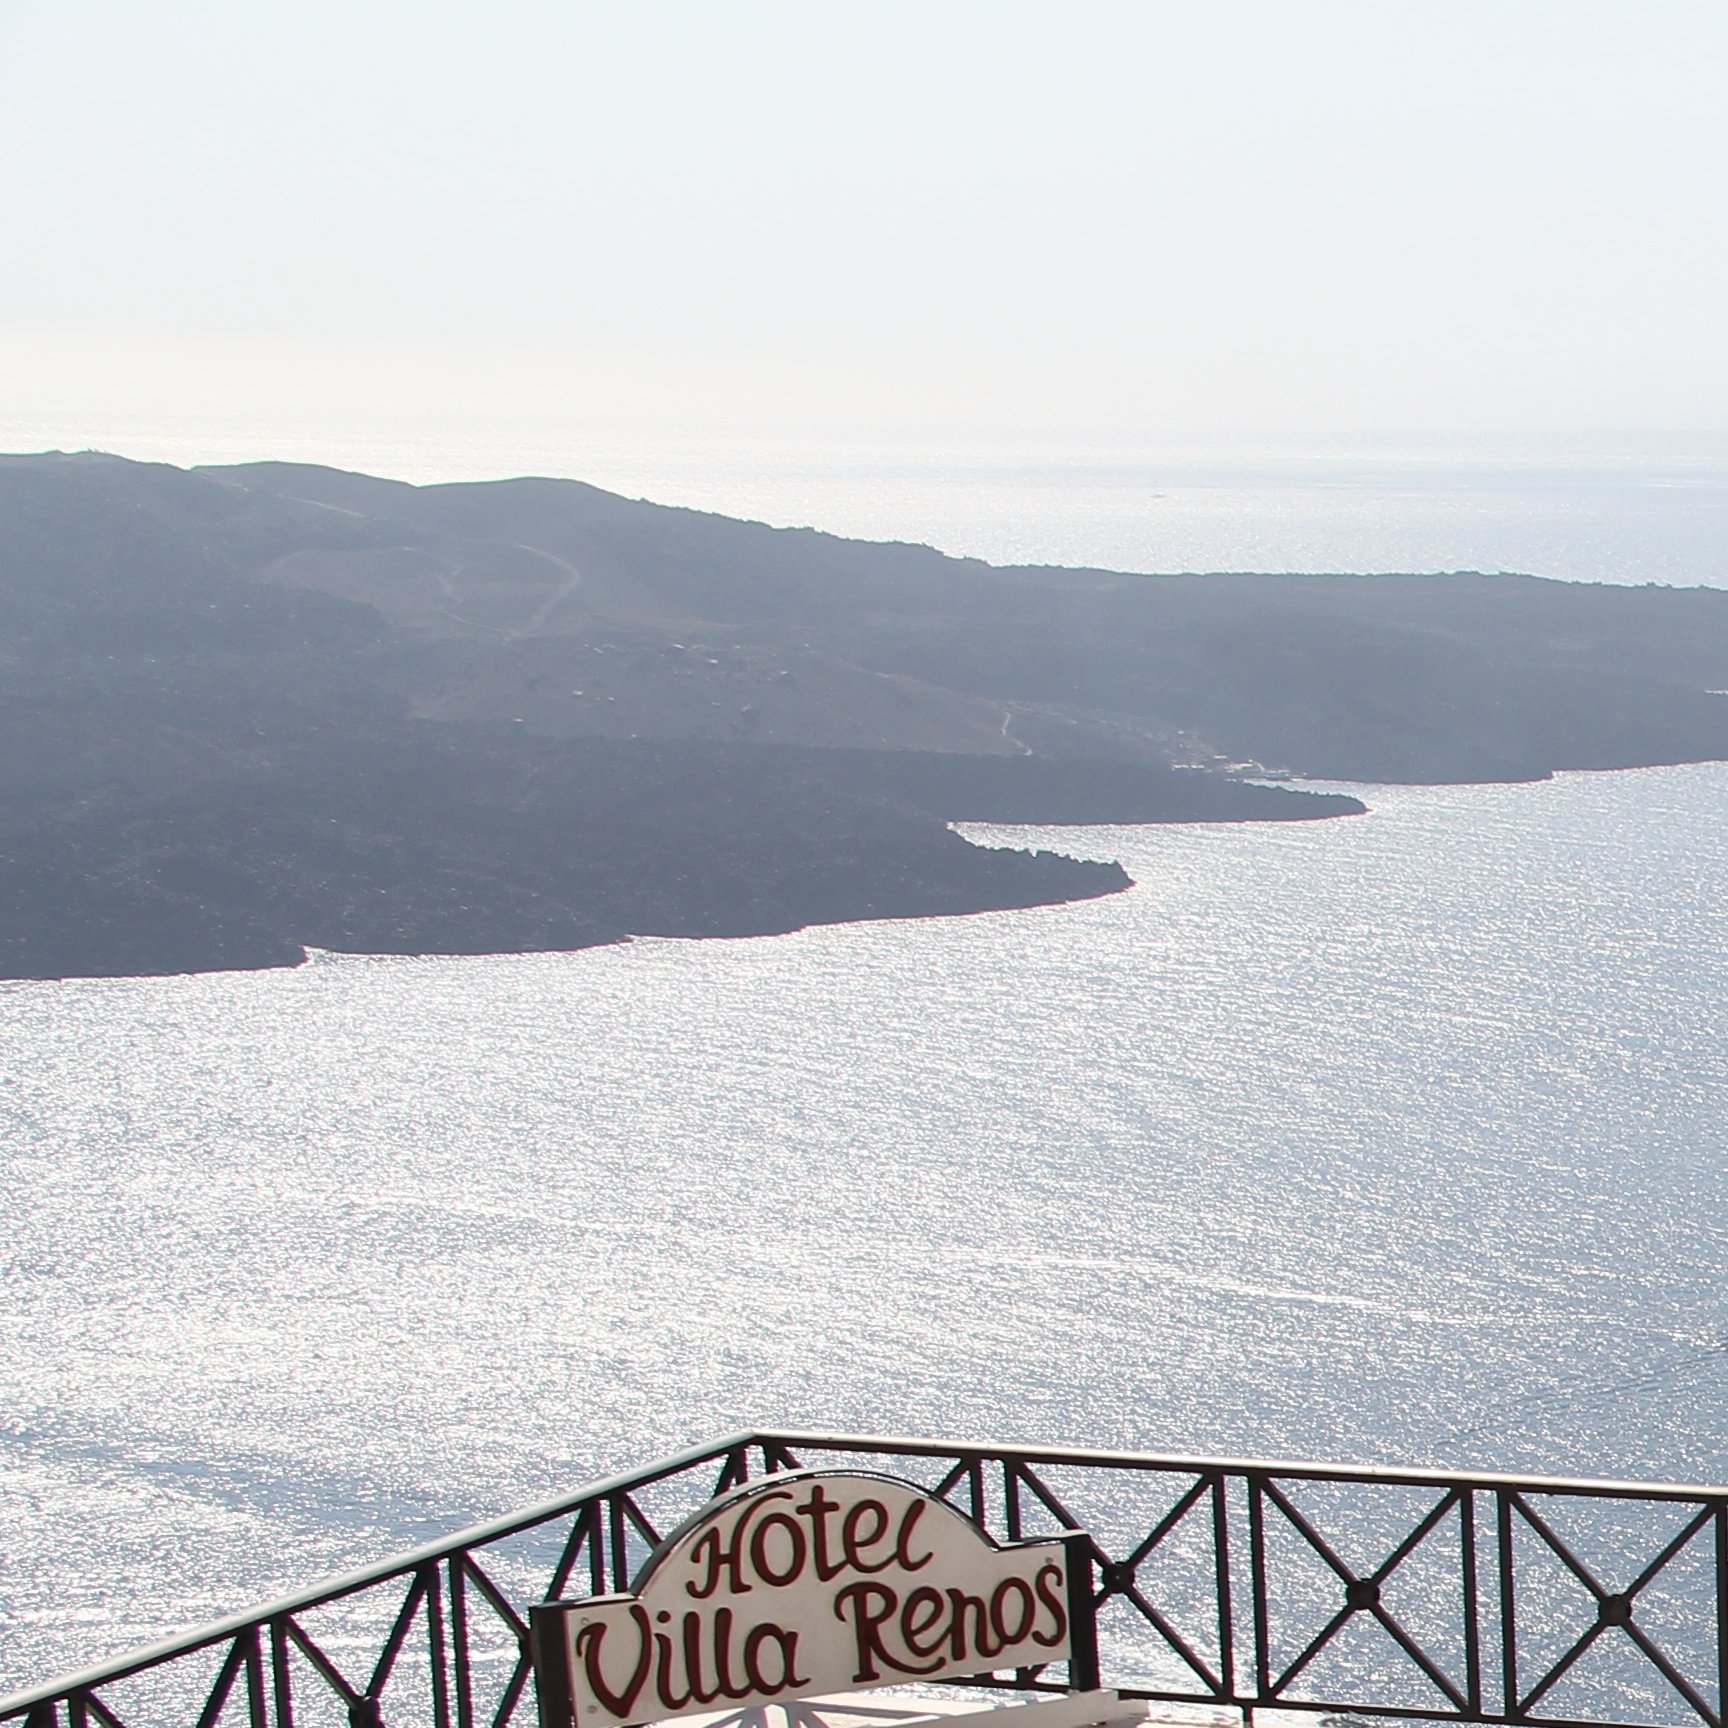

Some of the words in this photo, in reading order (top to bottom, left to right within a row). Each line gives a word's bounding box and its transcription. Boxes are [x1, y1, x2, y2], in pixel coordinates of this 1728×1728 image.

[686, 1486, 934, 1599] Hotel
[576, 1605, 811, 1719] Villa
[834, 1564, 1067, 1683] Renos
